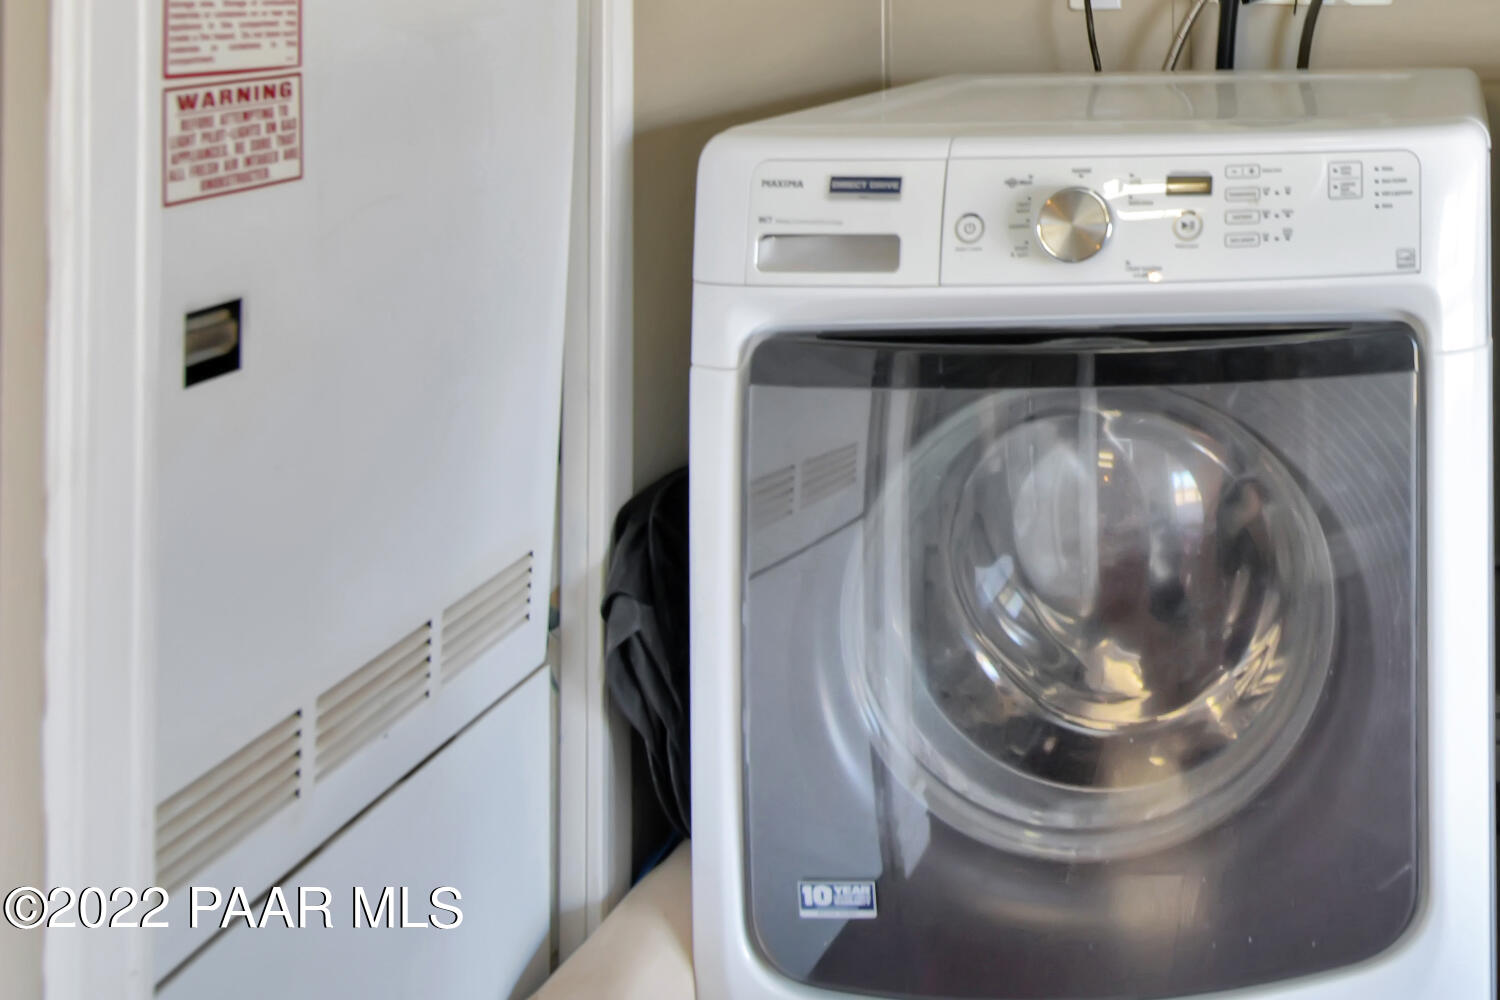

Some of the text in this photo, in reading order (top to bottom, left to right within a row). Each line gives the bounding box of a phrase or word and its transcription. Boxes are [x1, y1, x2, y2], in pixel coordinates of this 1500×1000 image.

[176, 81, 293, 111] WARNING
[761, 180, 804, 189] MAXIMA
[802, 885, 832, 906] 10
